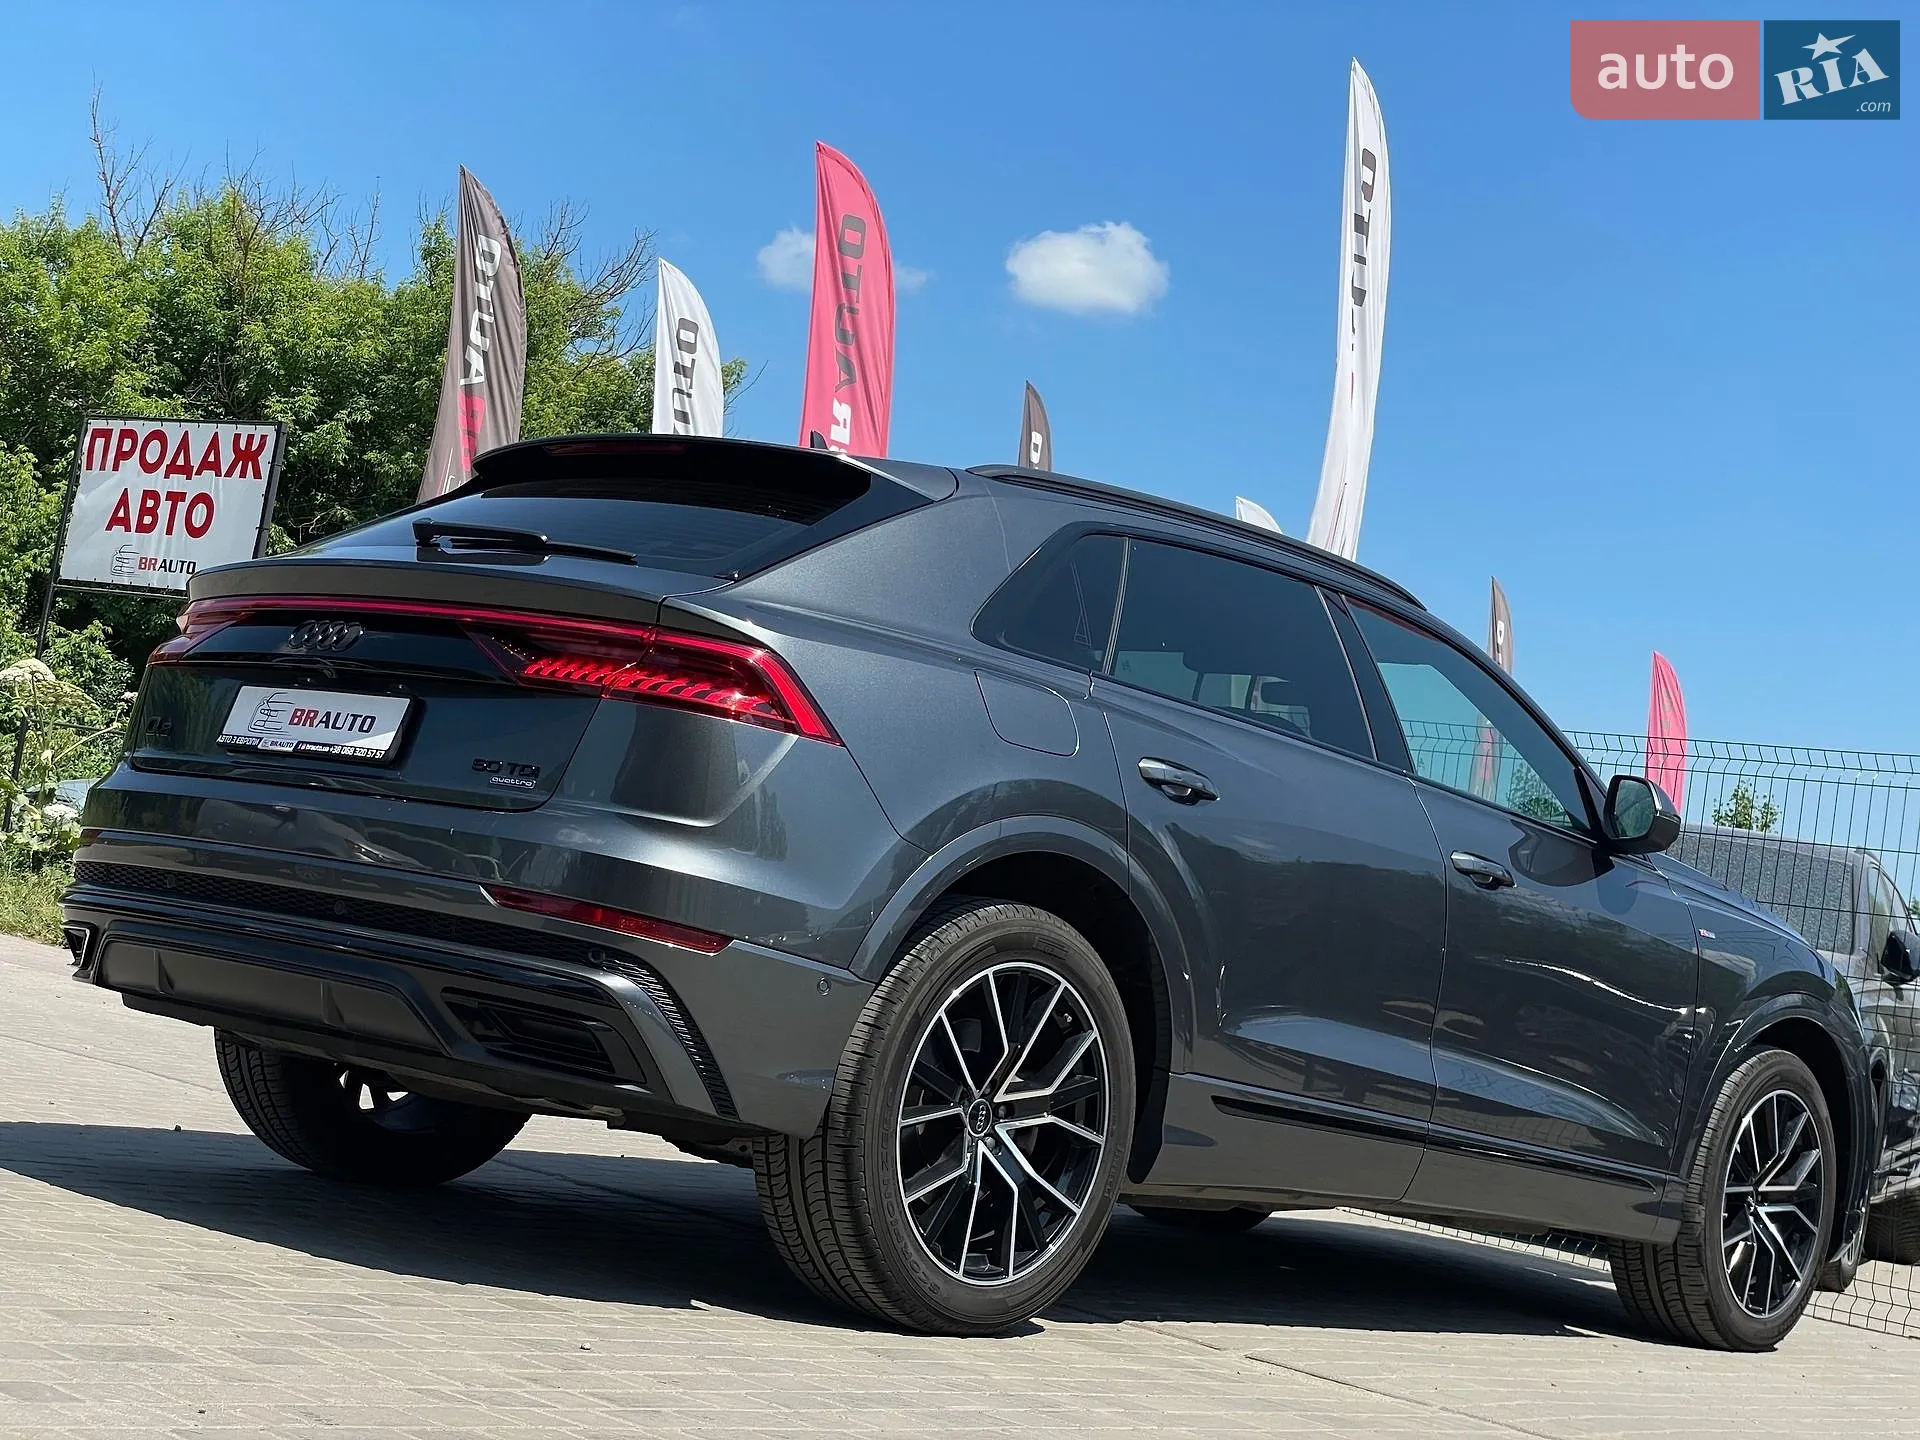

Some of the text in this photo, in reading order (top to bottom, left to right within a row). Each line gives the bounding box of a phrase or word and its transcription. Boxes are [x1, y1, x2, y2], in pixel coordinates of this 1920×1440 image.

[85, 427, 268, 480] ПРОДАЖ
[104, 487, 215, 539] АВТО
[138, 556, 197, 575] BRAUTO
[288, 707, 377, 734] BRAUTO
[269, 740, 294, 748] BRAUTO
[375, 750, 386, 759] 57
[491, 776, 533, 786] quattro
